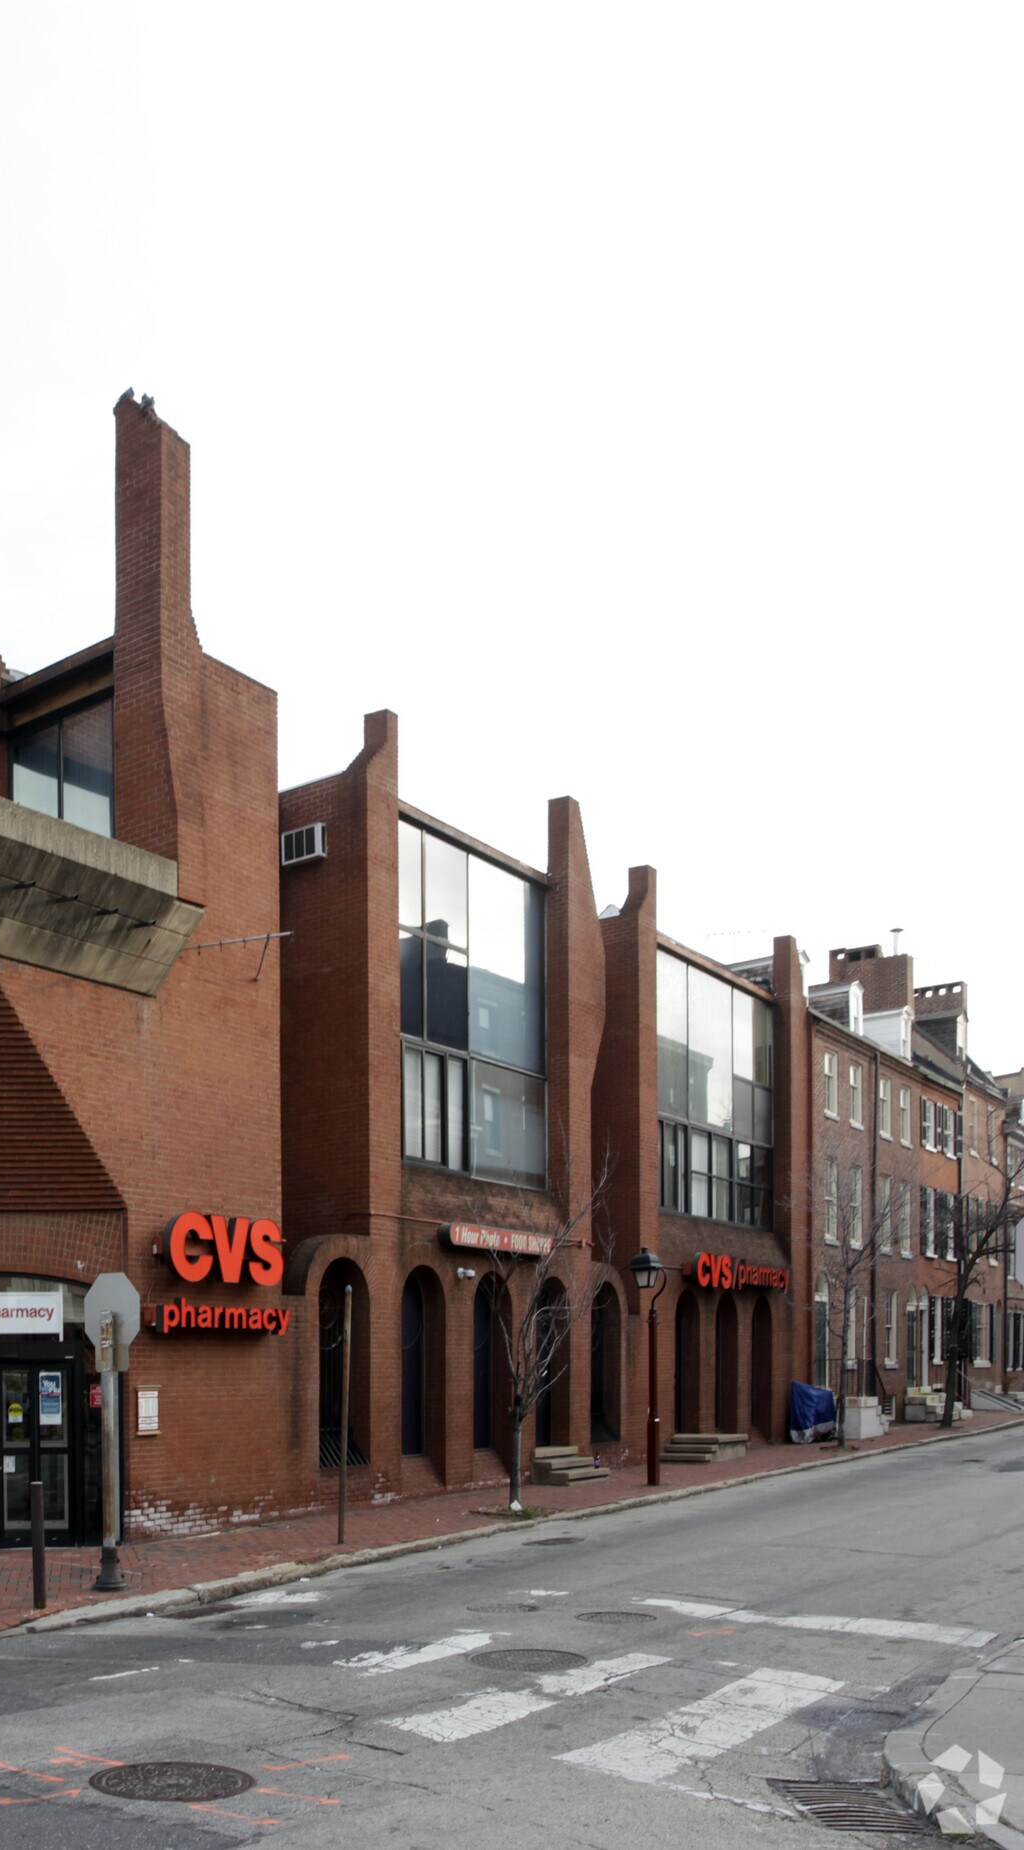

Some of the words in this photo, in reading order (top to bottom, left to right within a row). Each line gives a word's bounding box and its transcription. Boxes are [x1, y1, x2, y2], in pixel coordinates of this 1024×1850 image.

[170, 1211, 284, 1286] CVS
[455, 1226, 460, 1242] 1
[461, 1227, 479, 1245] Hour
[511, 1233, 528, 1250] FOOD
[163, 1297, 291, 1336] pharmacy
